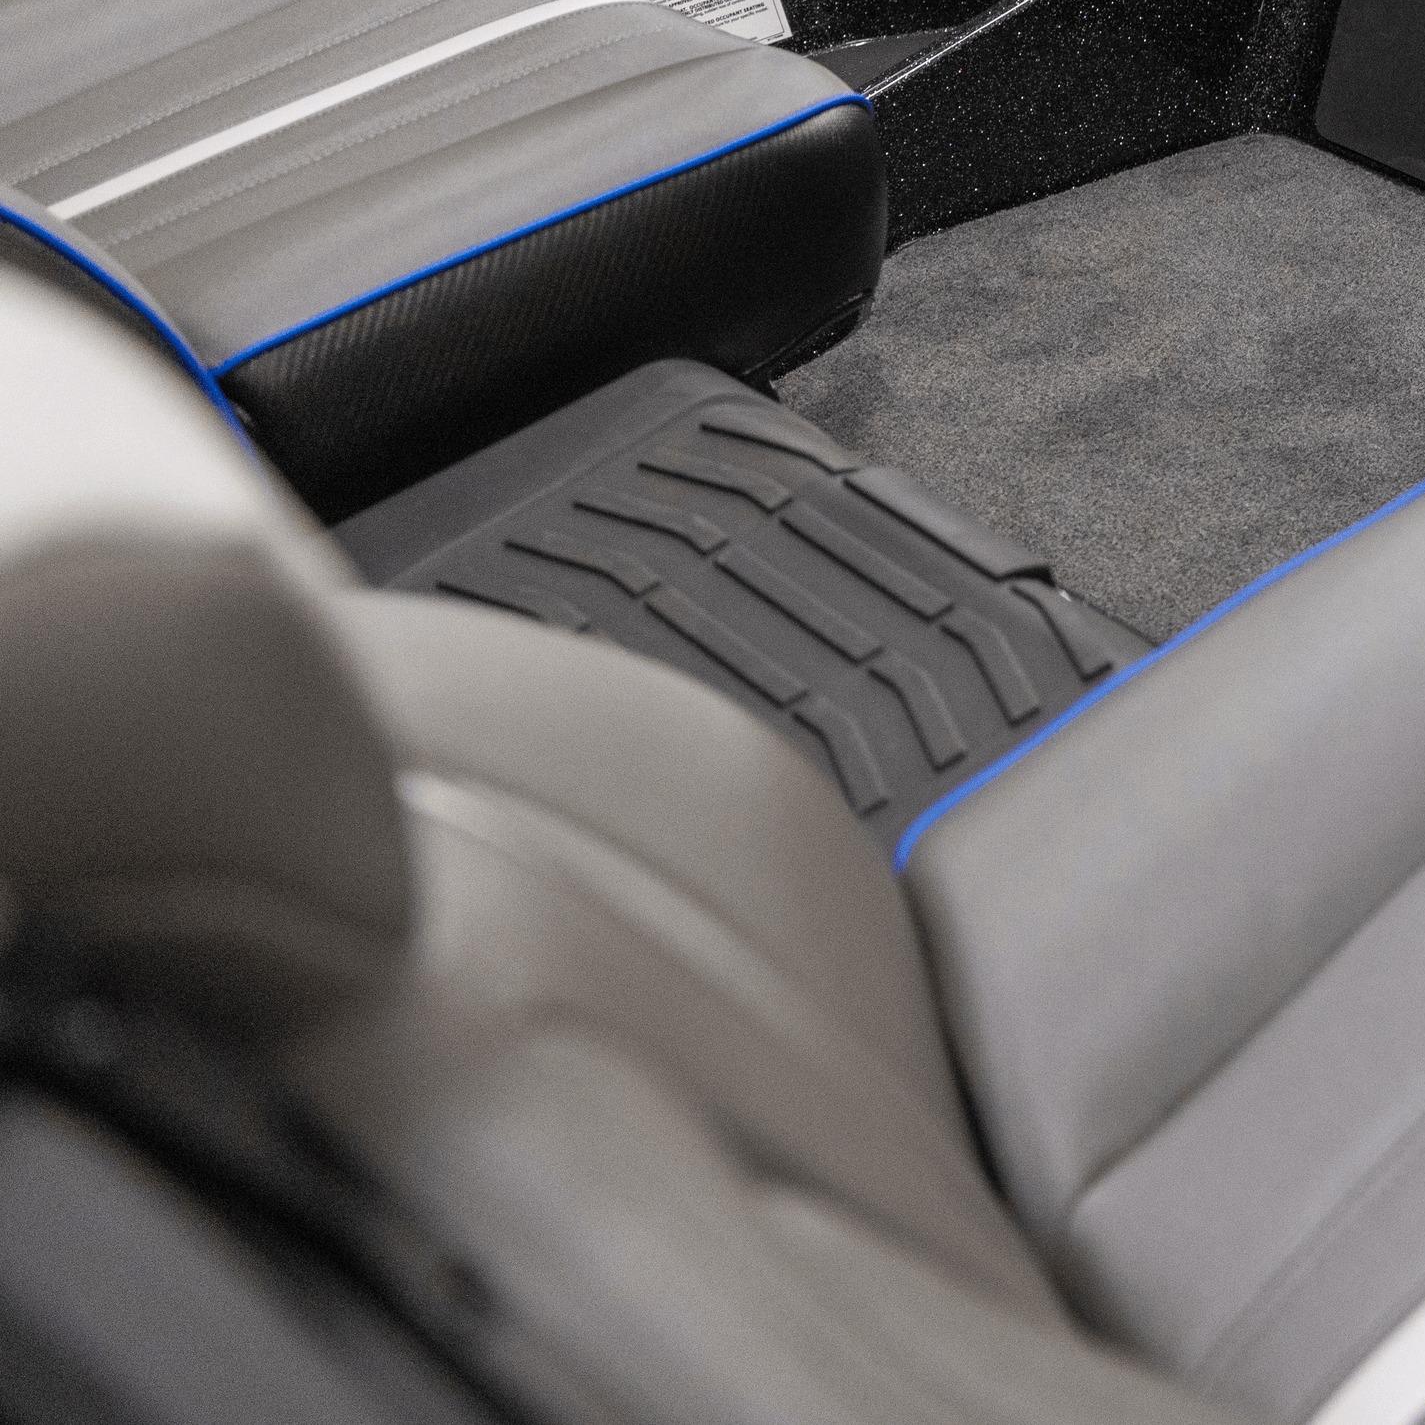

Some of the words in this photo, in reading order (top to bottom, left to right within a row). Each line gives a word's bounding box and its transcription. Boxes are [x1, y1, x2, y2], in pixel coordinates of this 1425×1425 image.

[694, 0, 723, 12] DISTRIBUTED
[714, 9, 742, 21] OCCUPANT
[743, 1, 765, 12] SEATING
